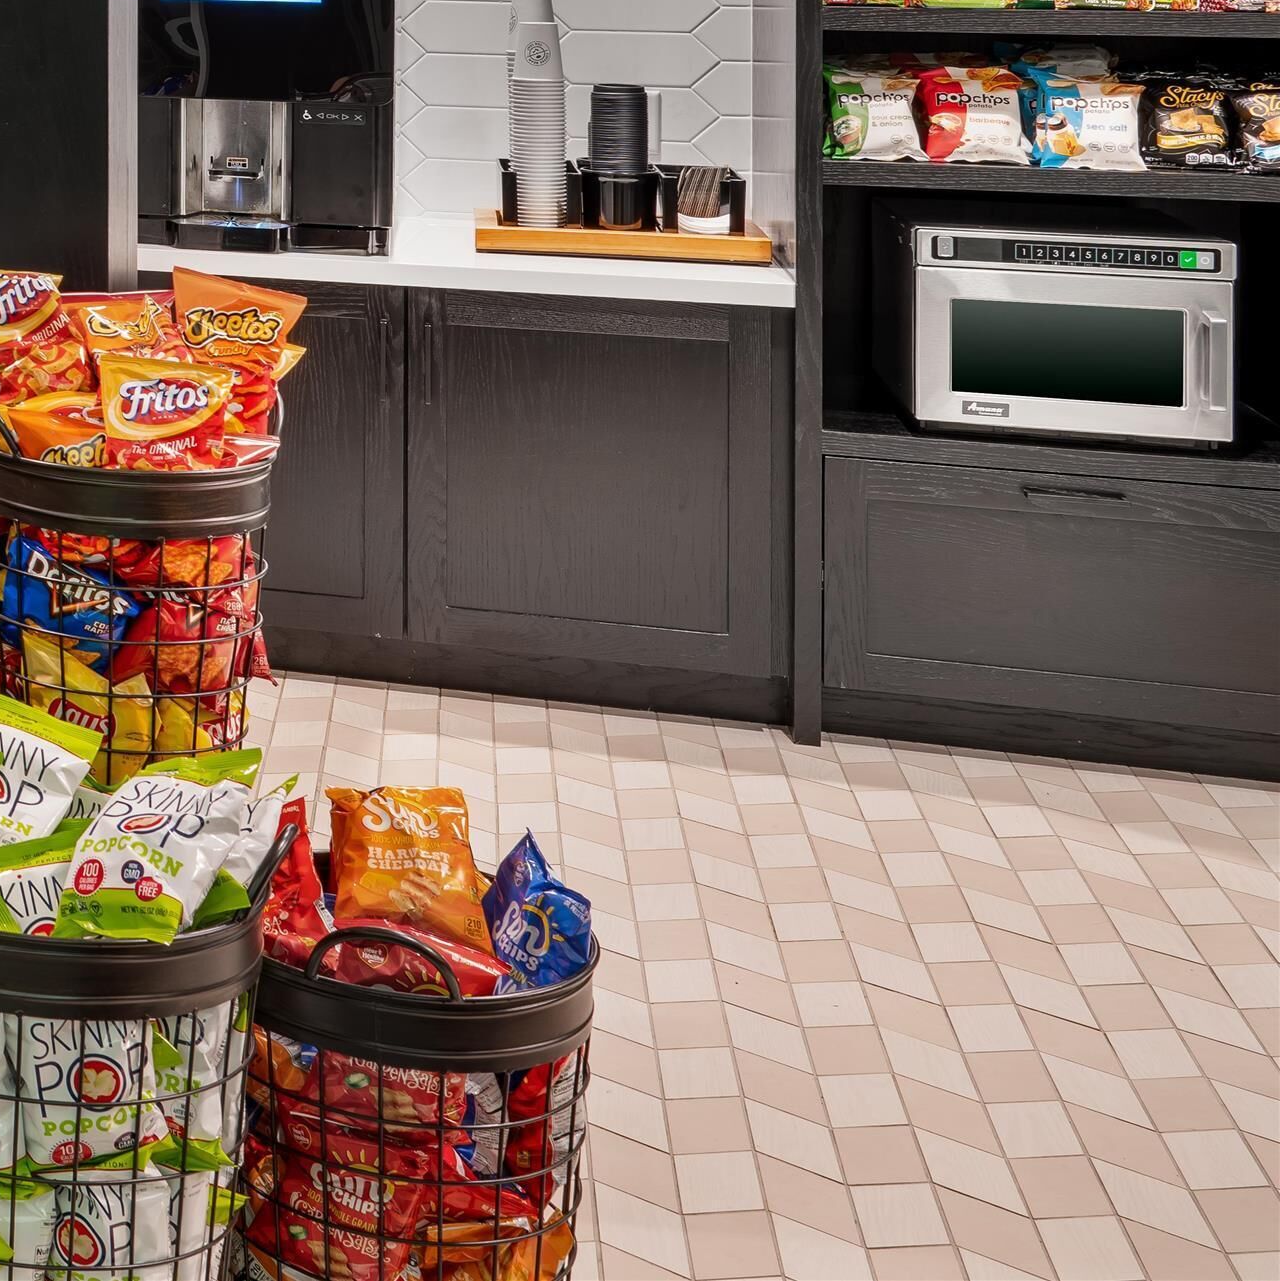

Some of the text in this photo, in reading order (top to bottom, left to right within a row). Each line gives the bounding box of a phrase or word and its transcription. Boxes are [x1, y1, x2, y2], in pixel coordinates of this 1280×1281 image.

[837, 92, 910, 108] popchips
[936, 91, 1011, 107] popchips
[1051, 96, 1130, 113] popchips
[1160, 84, 1225, 109] Stacy's
[1022, 248, 1174, 263] 1 2 3 4 5 6 7 8 9 0
[181, 307, 283, 348] Cheetos
[205, 343, 252, 357] Crunchy
[120, 379, 210, 421] Fritos
[131, 435, 198, 455] The ORIGINAL
[26, 550, 131, 617] Doritos
[121, 780, 229, 818] SKINNY
[362, 792, 440, 834] Sun
[80, 835, 184, 878] POPCORN
[366, 846, 451, 865] HARVEST
[81, 862, 100, 878] 100
[123, 869, 142, 881] GMO
[366, 857, 452, 876] CHEDDAR
[137, 885, 159, 899] FREE
[466, 917, 482, 929] 210
[496, 938, 539, 972] CHIPS
[350, 1216, 379, 1233] GRAIN
